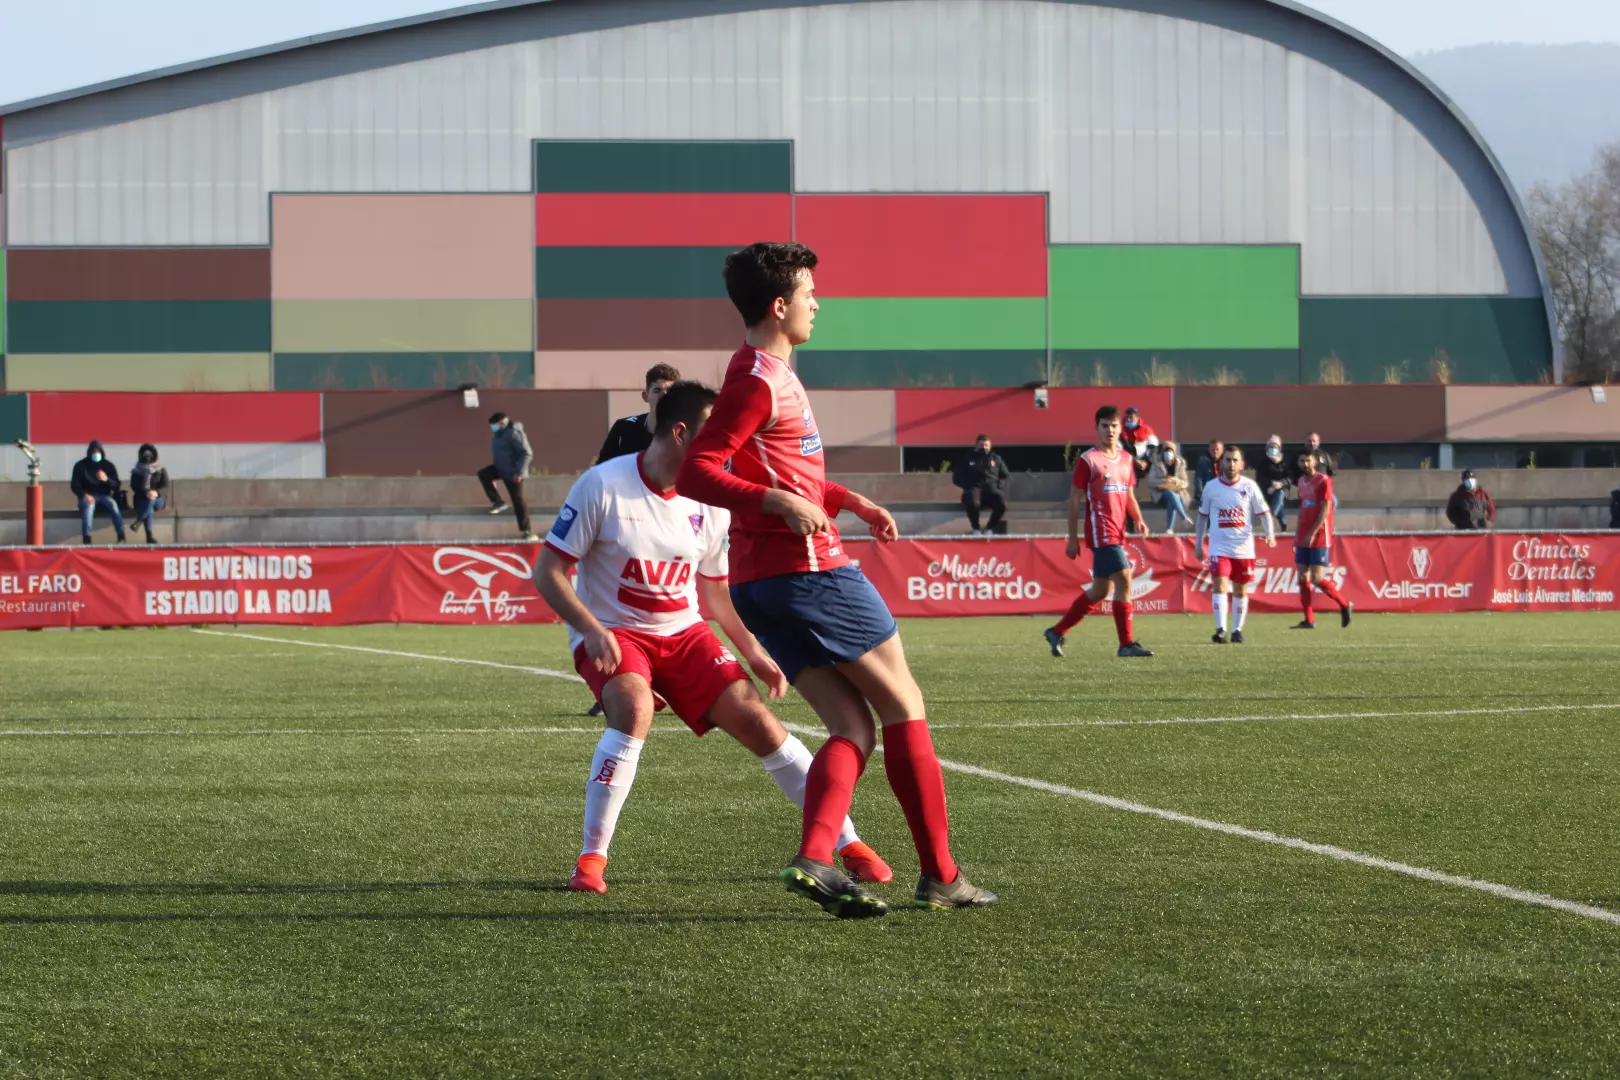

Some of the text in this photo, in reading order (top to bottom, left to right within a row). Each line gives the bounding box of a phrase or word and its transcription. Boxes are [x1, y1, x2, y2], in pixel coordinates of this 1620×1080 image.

[163, 555, 313, 581] BIENVENIDOS
[927, 553, 1015, 581] Muebles
[1264, 563, 1347, 594] VALÉS
[1507, 558, 1597, 580] Dentales
[1, 574, 82, 594] EL FARO
[907, 575, 1042, 600] Bernardo
[1367, 580, 1473, 599] Vallemar
[1492, 585, 1613, 603] José Luis Álvarez Medrano
[145, 588, 332, 615] ESTADIO LA ROJA
